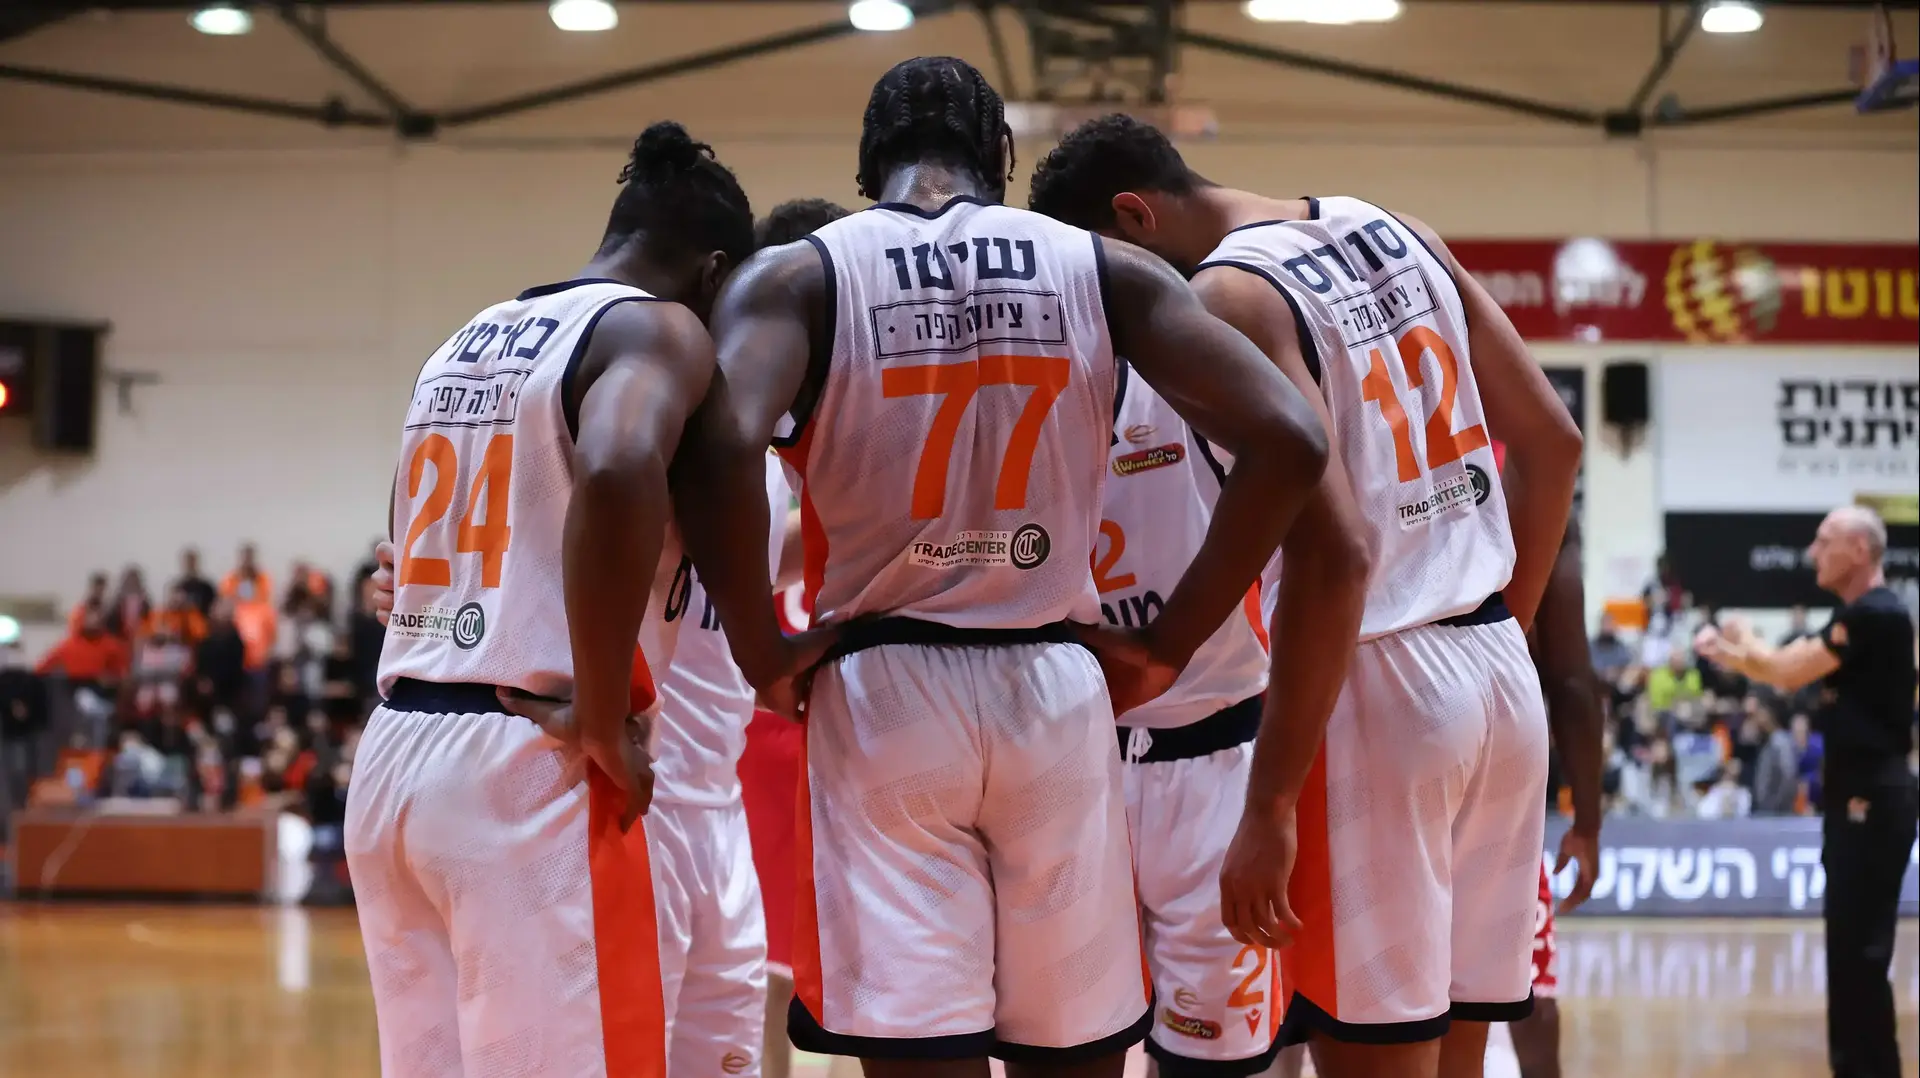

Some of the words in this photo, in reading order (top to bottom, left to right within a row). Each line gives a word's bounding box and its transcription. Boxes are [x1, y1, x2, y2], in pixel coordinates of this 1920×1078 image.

[885, 237, 1037, 290] שיטו
[914, 313, 961, 345] קפה
[1361, 325, 1490, 484] 12
[881, 354, 1071, 521] 77
[1780, 417, 1915, 447] יתנים
[1120, 457, 1166, 471] Winner
[398, 433, 513, 588] 24
[1399, 483, 1468, 519] TRADENTER
[914, 541, 1006, 559] TRADECENTER
[392, 613, 456, 632] TRADECENTE
[1772, 845, 1827, 911] קי
[1226, 943, 1268, 1008] 2
